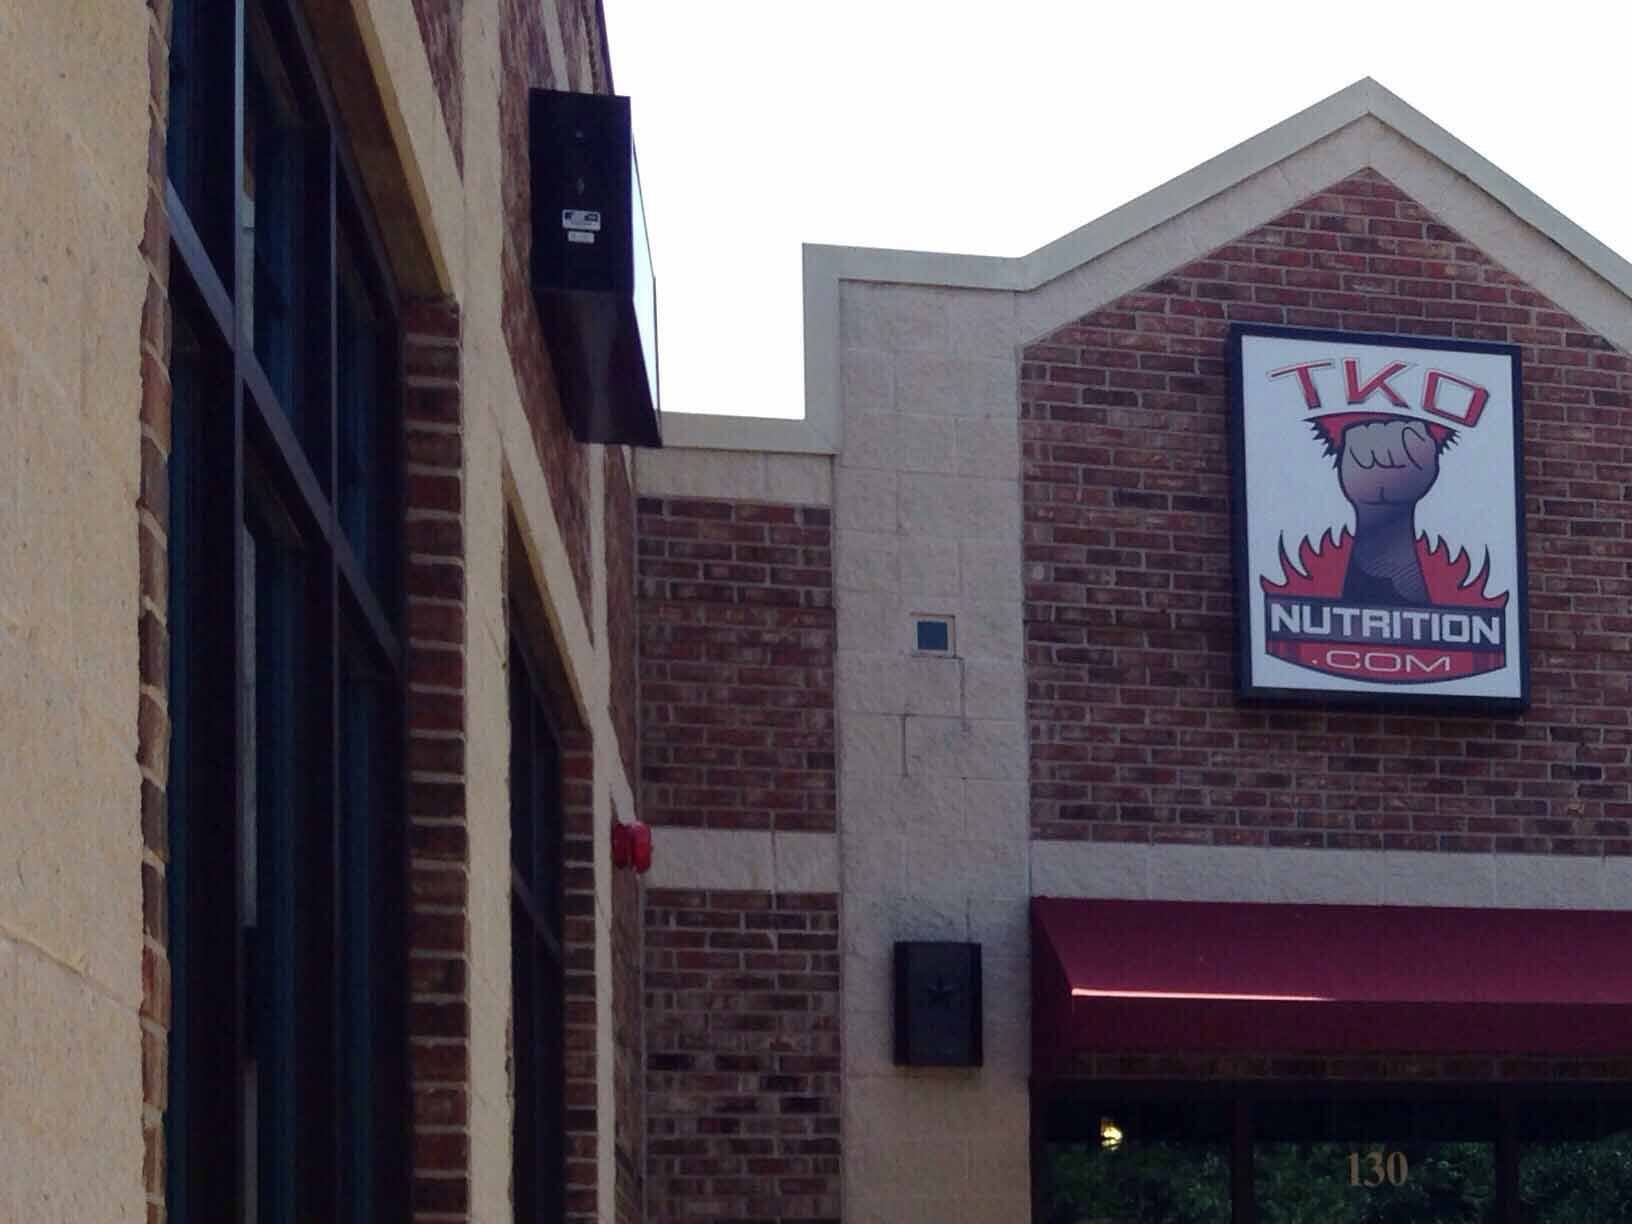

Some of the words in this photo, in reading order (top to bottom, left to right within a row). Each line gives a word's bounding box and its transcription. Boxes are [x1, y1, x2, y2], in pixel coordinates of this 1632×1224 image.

[1266, 357, 1491, 428] TKO
[1270, 602, 1501, 645] NUTRITION
[1311, 649, 1452, 673] .COM
[1346, 1150, 1409, 1187] 130
